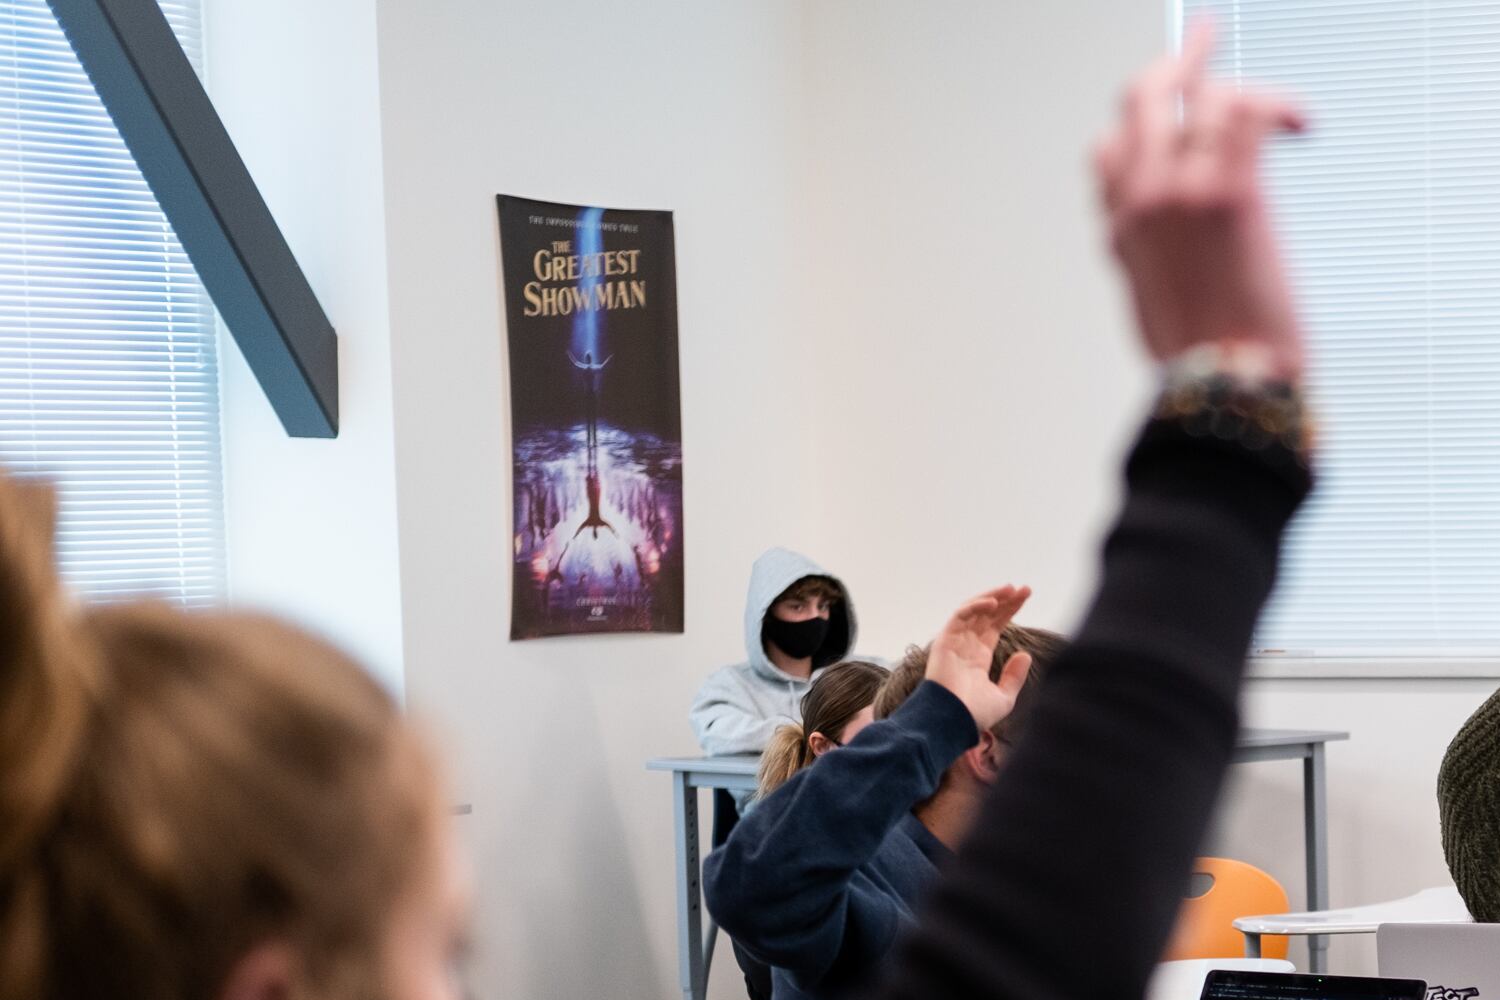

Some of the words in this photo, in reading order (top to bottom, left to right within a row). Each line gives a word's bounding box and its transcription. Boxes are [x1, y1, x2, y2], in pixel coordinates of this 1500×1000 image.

[552, 240, 571, 254] THE
[533, 249, 641, 281] GREATEST
[523, 279, 647, 317] SHOWMAN
